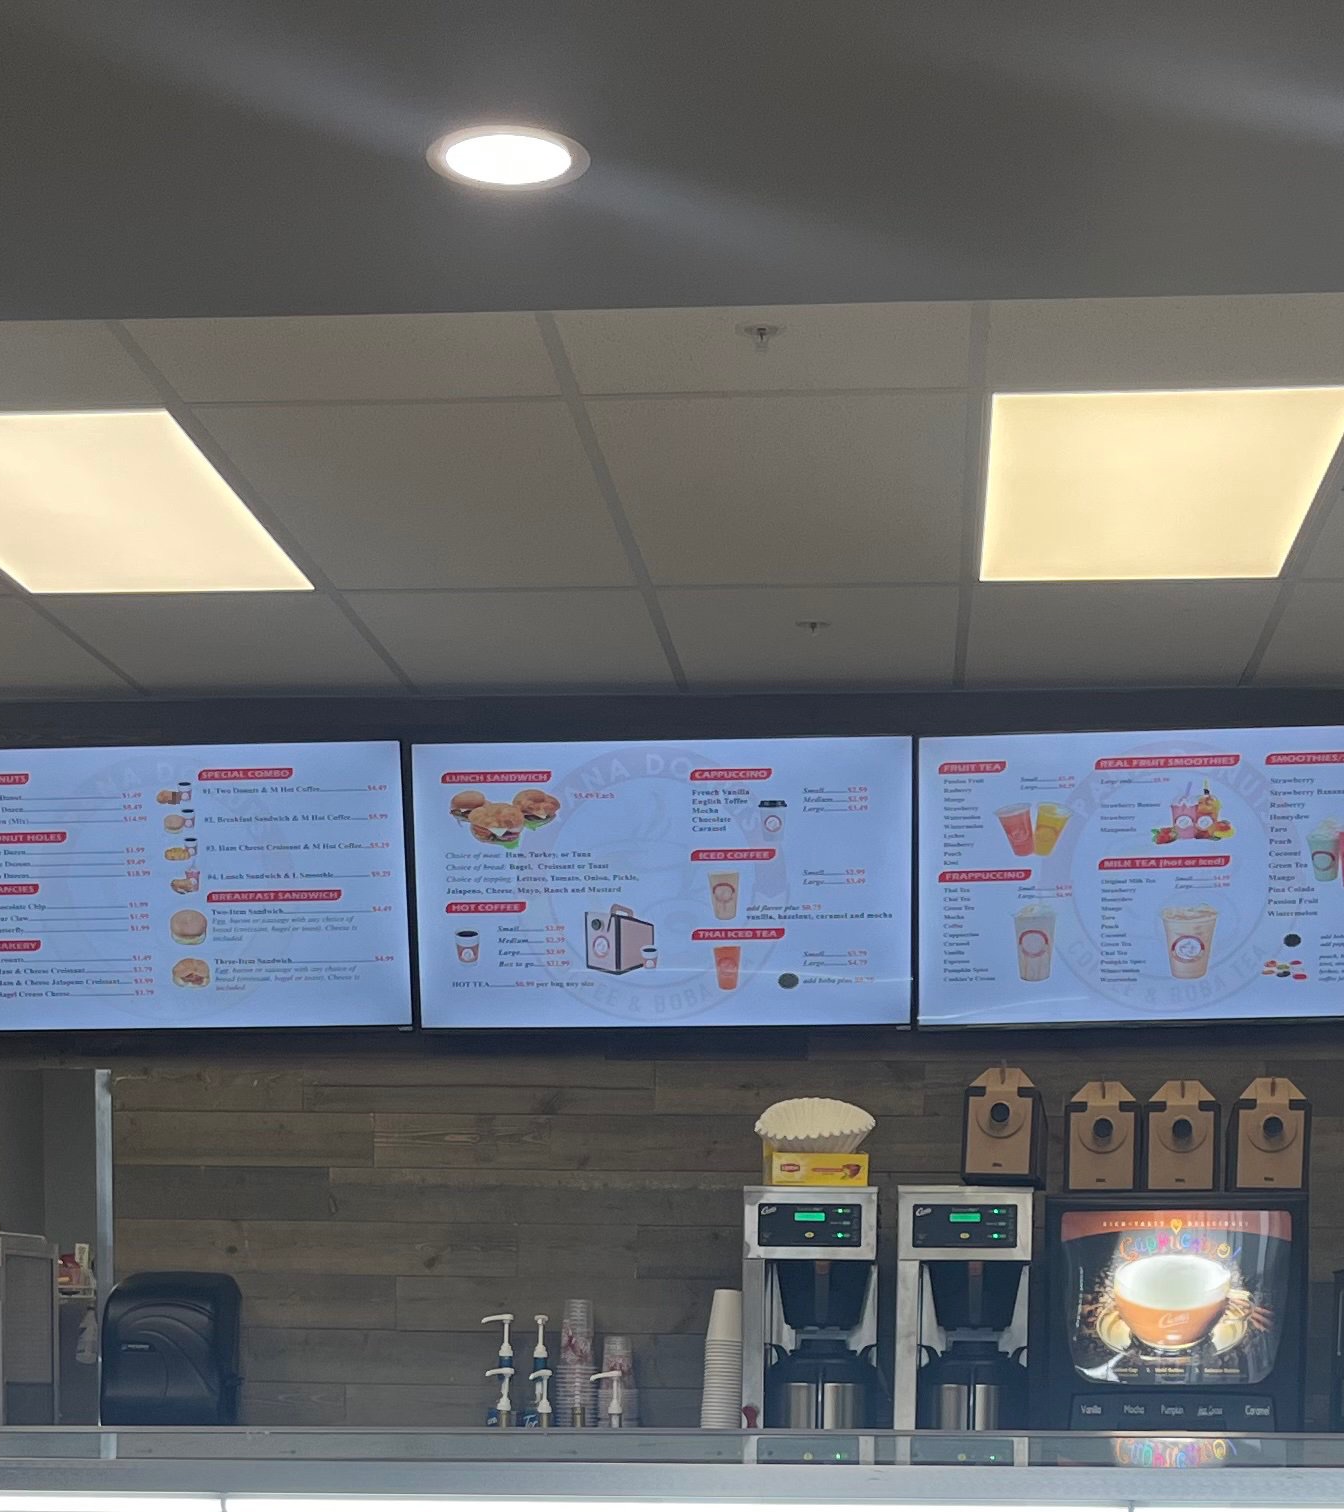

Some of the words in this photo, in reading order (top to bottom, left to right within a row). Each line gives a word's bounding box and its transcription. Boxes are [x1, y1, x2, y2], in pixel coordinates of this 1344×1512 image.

[943, 763, 977, 772] FRUIT
[979, 762, 1001, 771] TEA
[1099, 759, 1130, 768] REAL
[1132, 758, 1165, 767] FRUIT
[1167, 757, 1235, 766] SMOOTHIES
[201, 770, 246, 779] SPECIAL
[247, 769, 290, 778] COMBO
[446, 774, 484, 782] LUNCH
[486, 773, 548, 782] SANDWICH
[694, 770, 768, 779] CAPPUCCINO
[1269, 789, 1314, 797] Strawberry
[691, 798, 722, 806] English
[723, 797, 748, 805] Toffee
[26, 833, 62, 842] HOLES
[698, 851, 725, 860] ICED
[726, 851, 770, 859] COFFEE
[1103, 860, 1132, 868] MILK
[1134, 859, 1156, 868] TEA
[945, 871, 1025, 880] FRAPPUCCINO
[211, 892, 275, 901] BREAKFAST
[277, 891, 338, 900] SANDWICH
[451, 903, 477, 912] HOT
[478, 902, 520, 912] COFFEE
[698, 930, 727, 939] THAI
[727, 930, 753, 938] ICED
[756, 930, 777, 938] TEA
[1080, 1404, 1102, 1415] Vanilla
[1123, 1404, 1145, 1415] Mocha
[1244, 1404, 1271, 1415] Caramel
